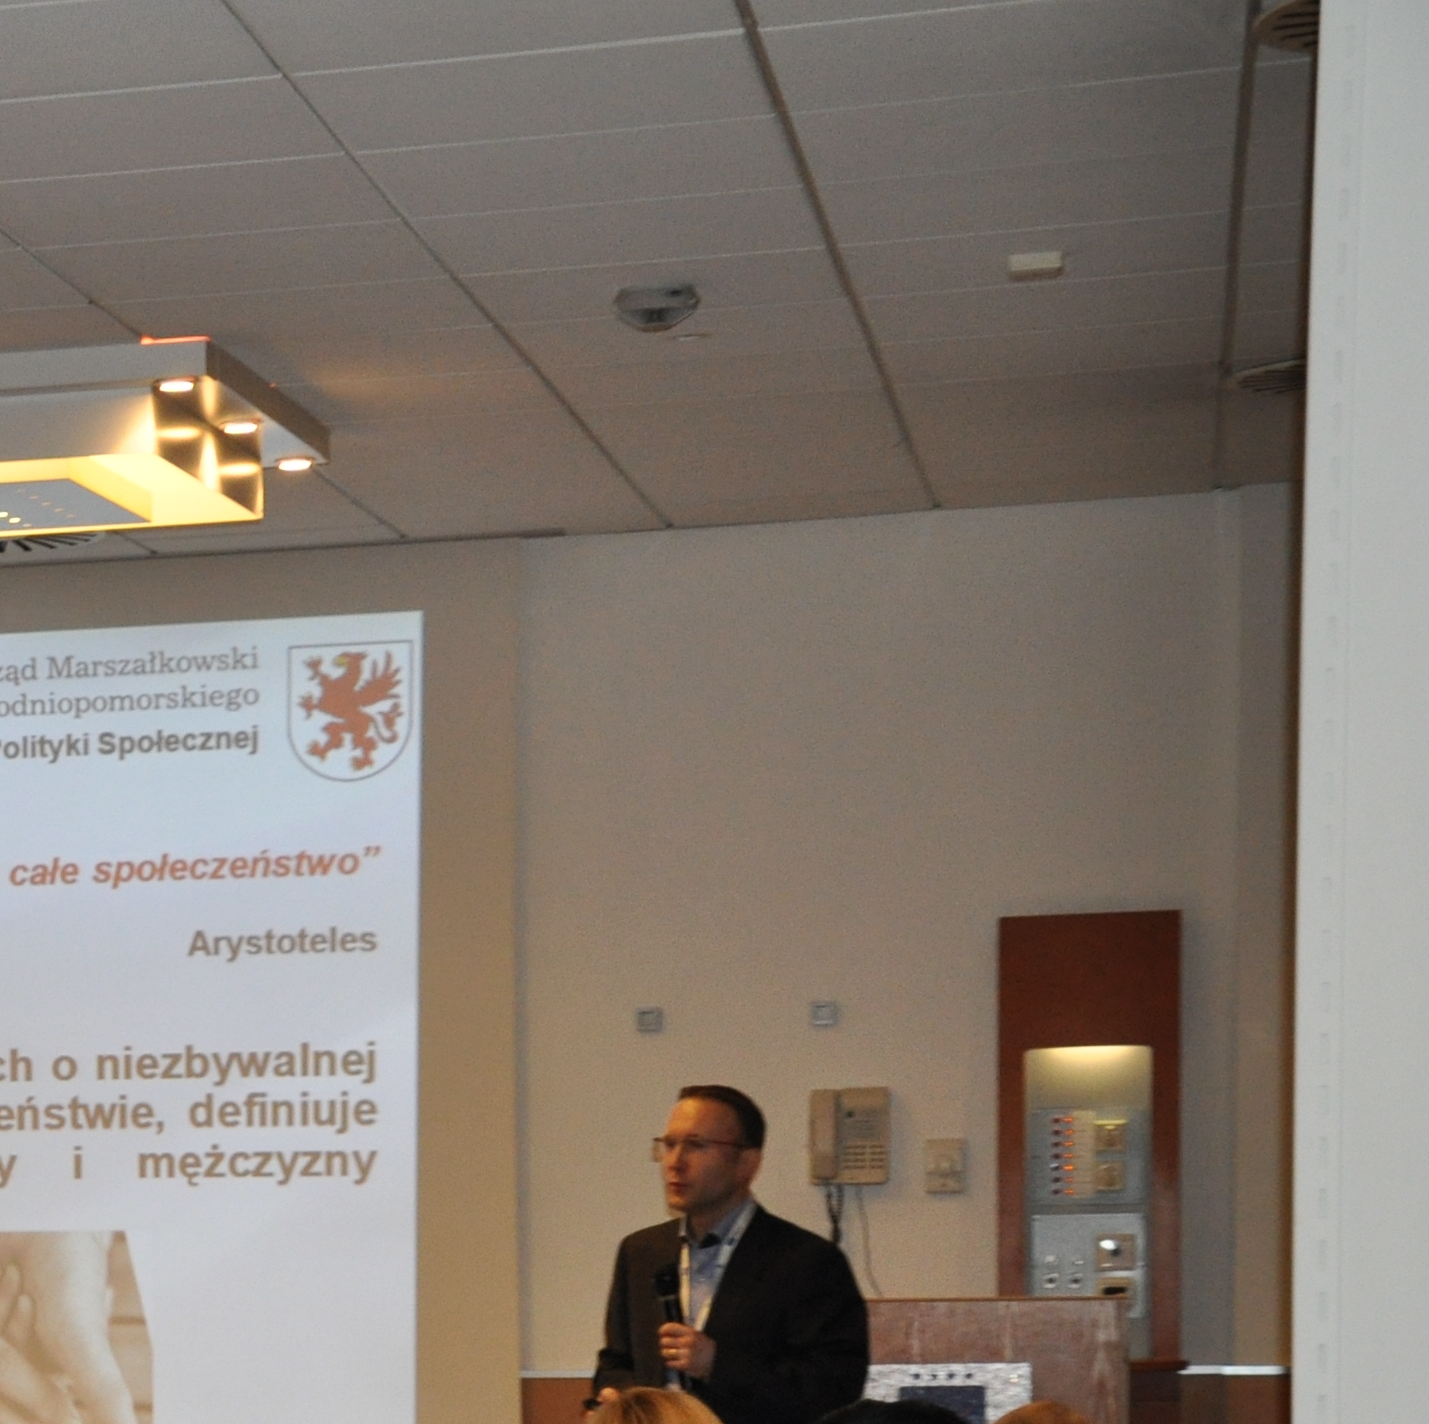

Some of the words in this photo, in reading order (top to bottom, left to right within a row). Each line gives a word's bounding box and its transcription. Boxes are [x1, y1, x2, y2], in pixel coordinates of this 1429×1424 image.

[46, 645, 260, 680] Marszałkowski
[97, 725, 260, 761] Społecznej
[8, 856, 80, 887] całe
[186, 925, 379, 963] Arystoteles
[51, 1054, 79, 1082] o
[96, 1041, 378, 1086] niezbywalnej
[189, 1090, 379, 1136] definiuje
[72, 1145, 83, 1180] i
[137, 1143, 379, 1188] mężczyzny
